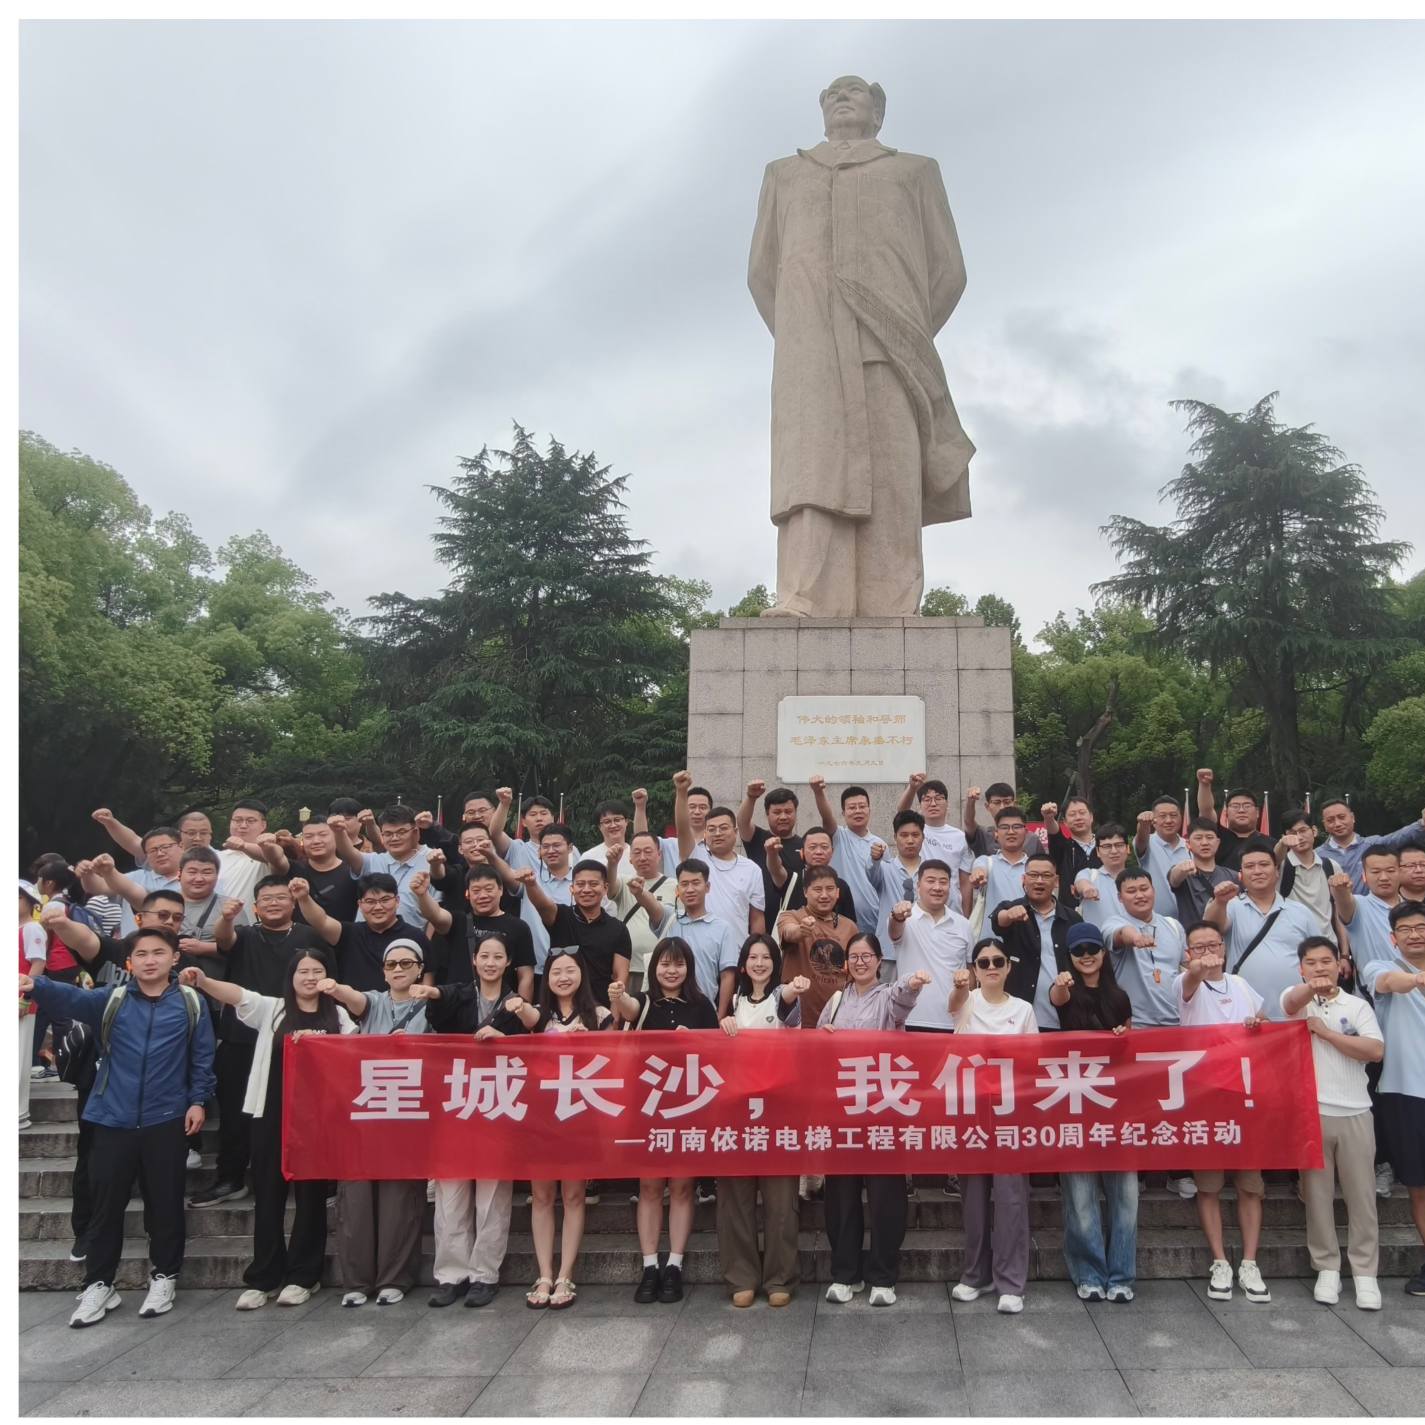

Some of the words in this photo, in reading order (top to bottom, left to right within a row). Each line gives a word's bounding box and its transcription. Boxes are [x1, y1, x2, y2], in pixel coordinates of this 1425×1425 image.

[797, 714, 906, 725] 伟大的领袖和导师
[790, 735, 913, 746] 毛泽东主席永垂不朽
